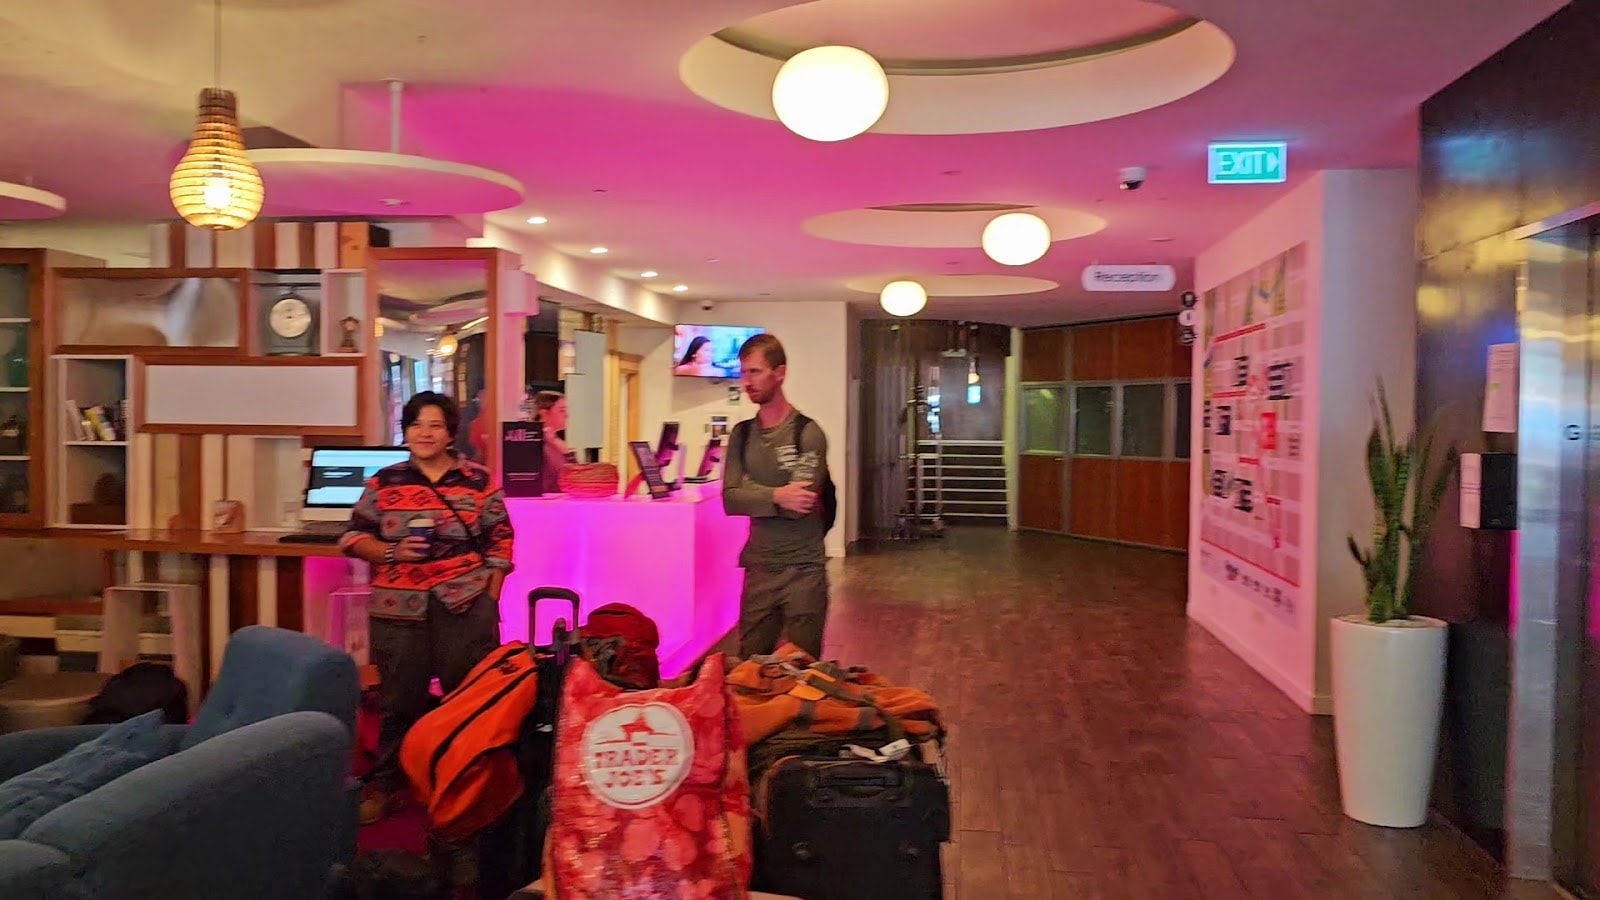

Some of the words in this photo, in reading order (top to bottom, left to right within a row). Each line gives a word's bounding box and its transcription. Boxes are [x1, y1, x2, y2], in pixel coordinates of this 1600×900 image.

[1216, 151, 1265, 175] EXIT
[1093, 270, 1164, 284] Reception
[594, 748, 680, 769] TRADER
[604, 769, 667, 789] JOE'S
